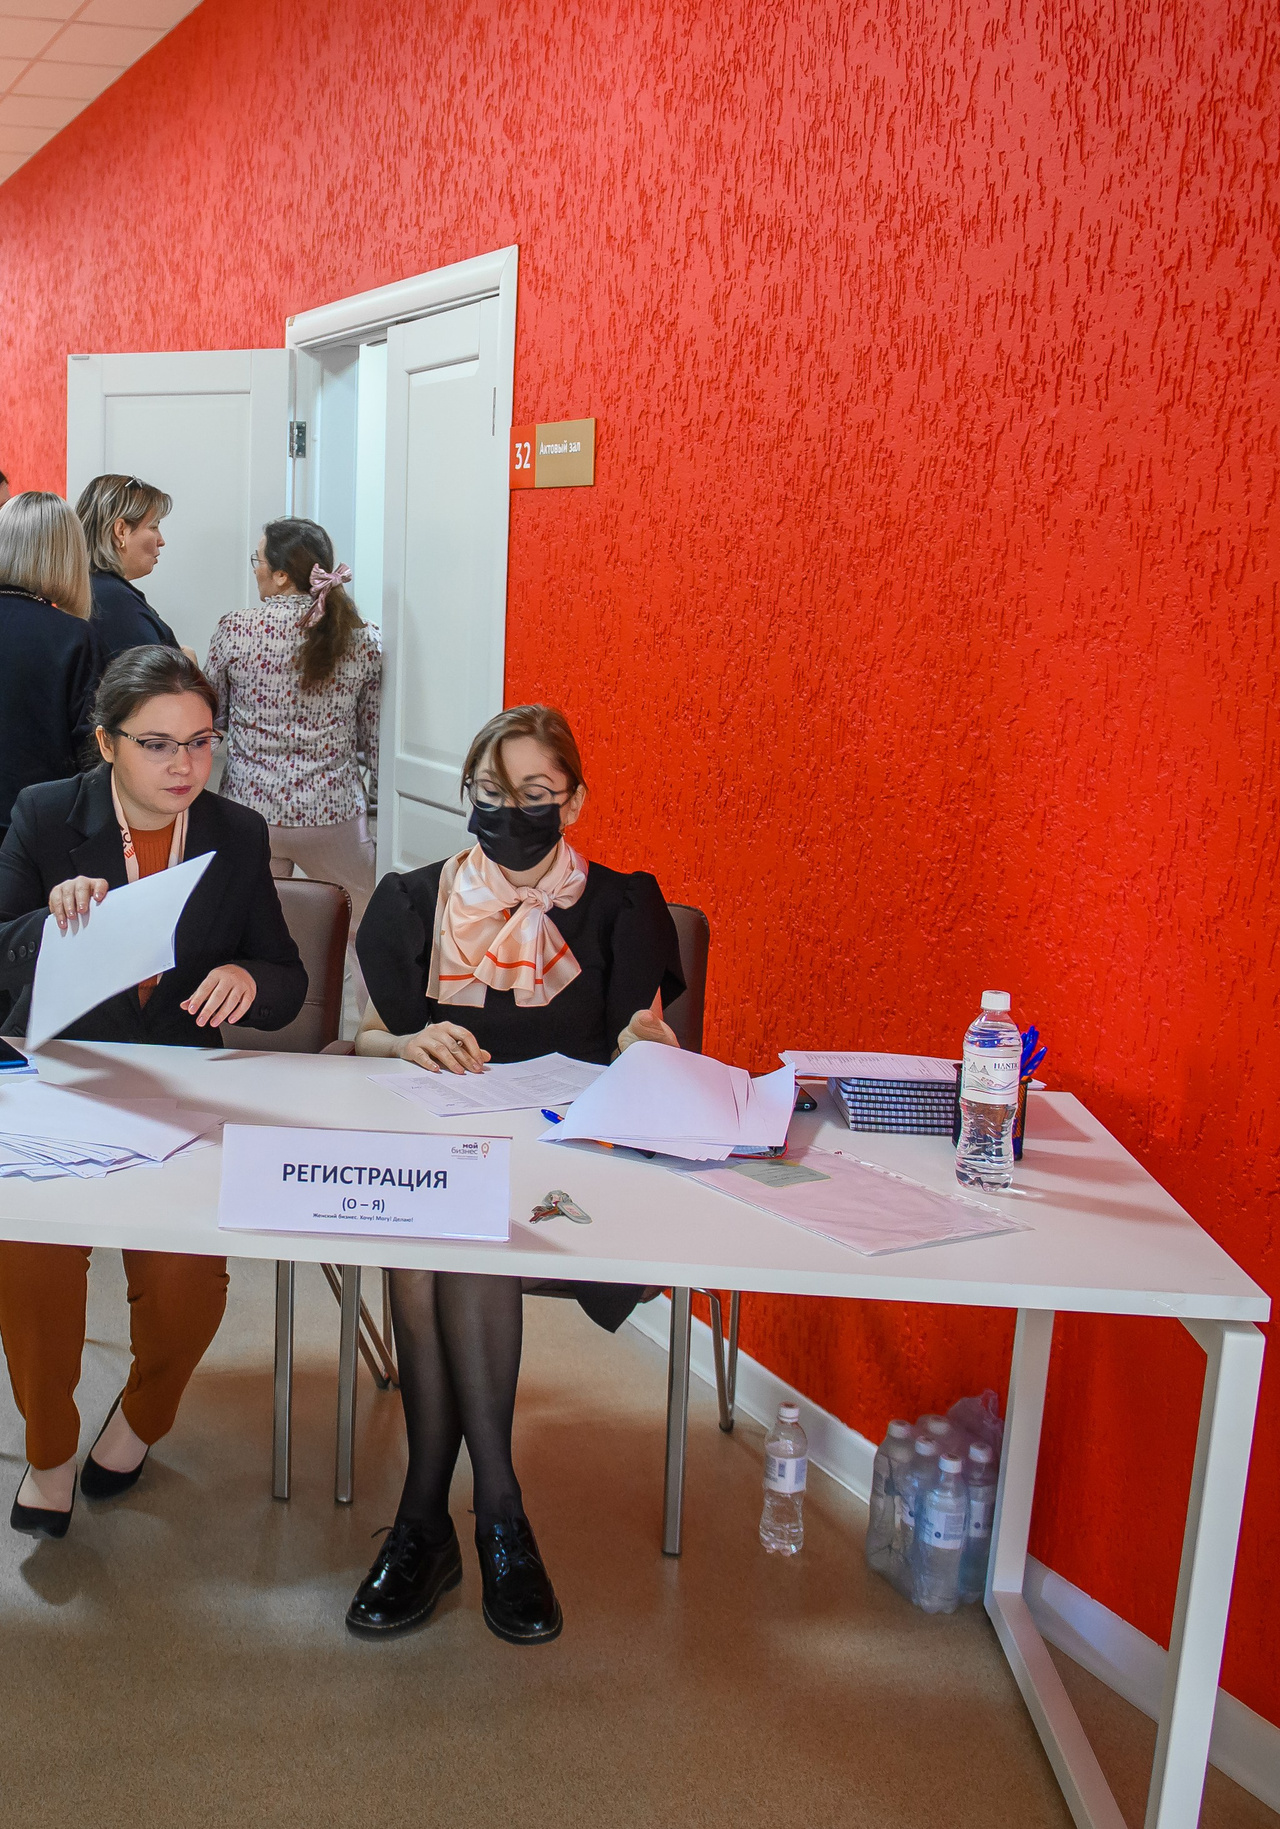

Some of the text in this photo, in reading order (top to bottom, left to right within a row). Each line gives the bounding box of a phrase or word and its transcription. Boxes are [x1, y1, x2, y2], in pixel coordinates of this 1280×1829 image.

[514, 440, 581, 470] 32 Актовый зал
[451, 1146, 478, 1155] бизнес
[282, 1163, 448, 1191] РЕГИСТРАЦИЯ
[342, 1197, 357, 1211] (О
[372, 1199, 385, 1213] Я)
